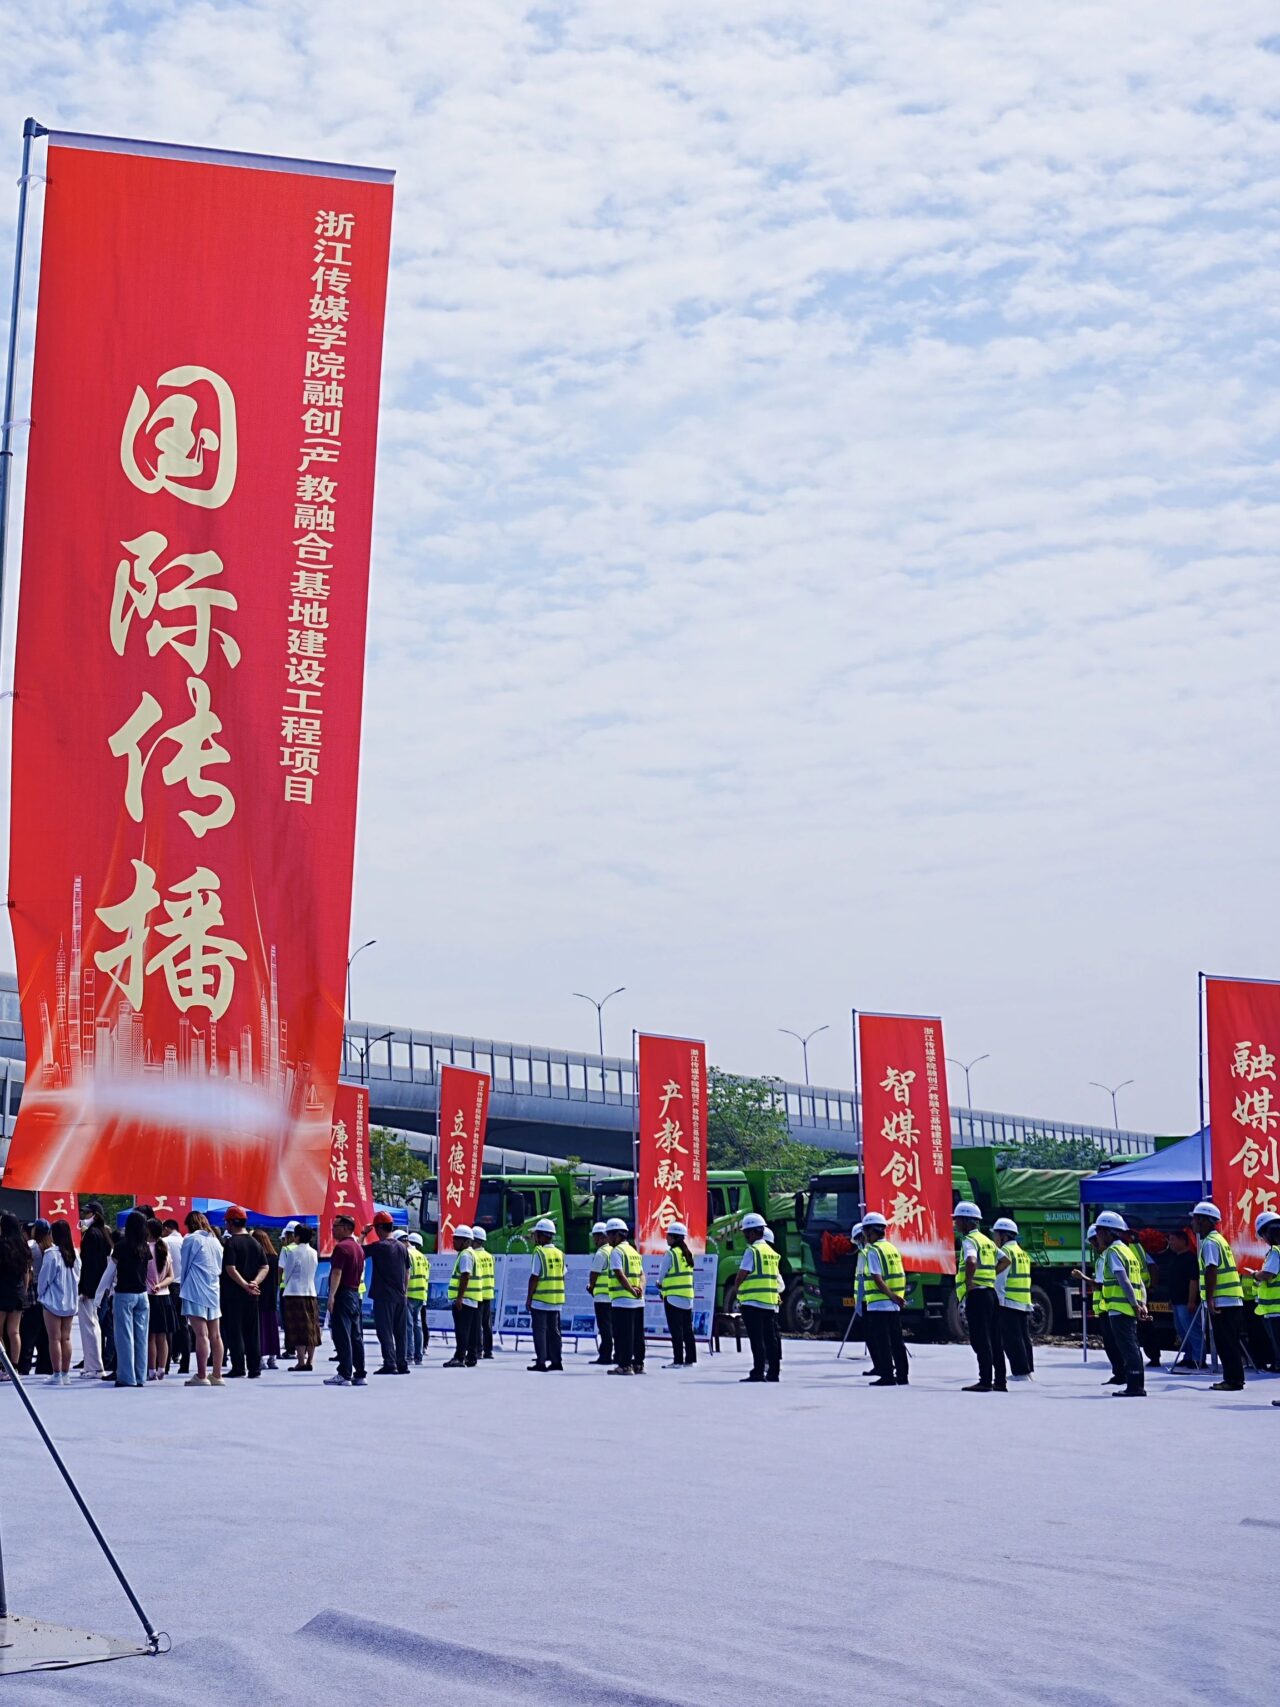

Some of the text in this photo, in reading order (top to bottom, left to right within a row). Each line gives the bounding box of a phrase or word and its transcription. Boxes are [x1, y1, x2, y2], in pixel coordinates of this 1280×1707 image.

[280, 210, 355, 806] 浙江传媒学院融创（产教融合）基地建设工程项目
[94, 365, 247, 1024] 国际传播
[652, 1079, 688, 1229] 产教融合
[879, 1066, 926, 1235] 智媒创新
[1229, 1041, 1280, 1224] 融媒创作
